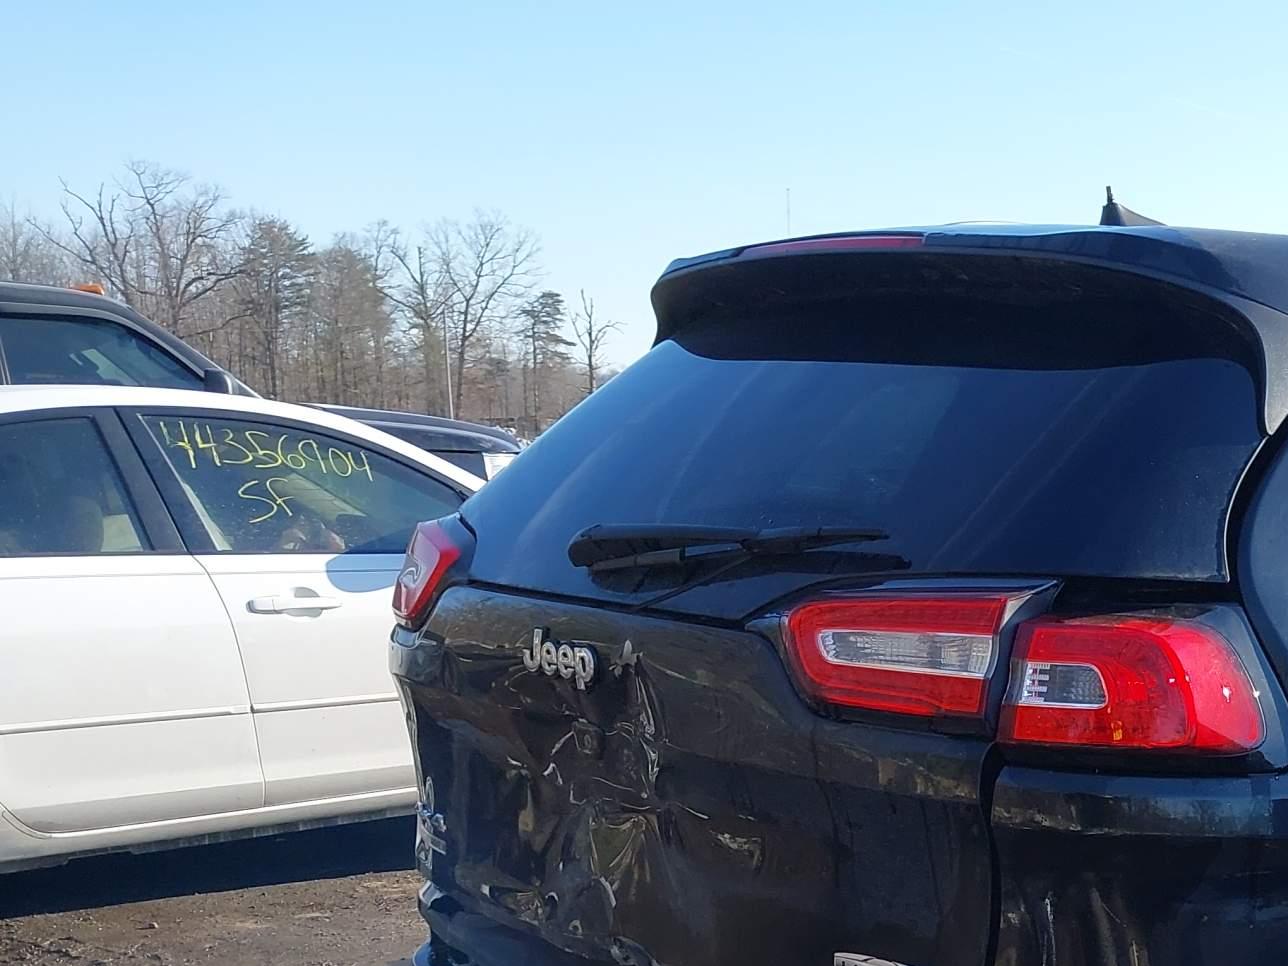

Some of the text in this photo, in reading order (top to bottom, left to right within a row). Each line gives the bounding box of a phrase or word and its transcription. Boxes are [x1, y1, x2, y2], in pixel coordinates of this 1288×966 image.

[159, 420, 374, 482] 44356904
[237, 477, 296, 524] SF
[522, 628, 595, 691] Jeep
